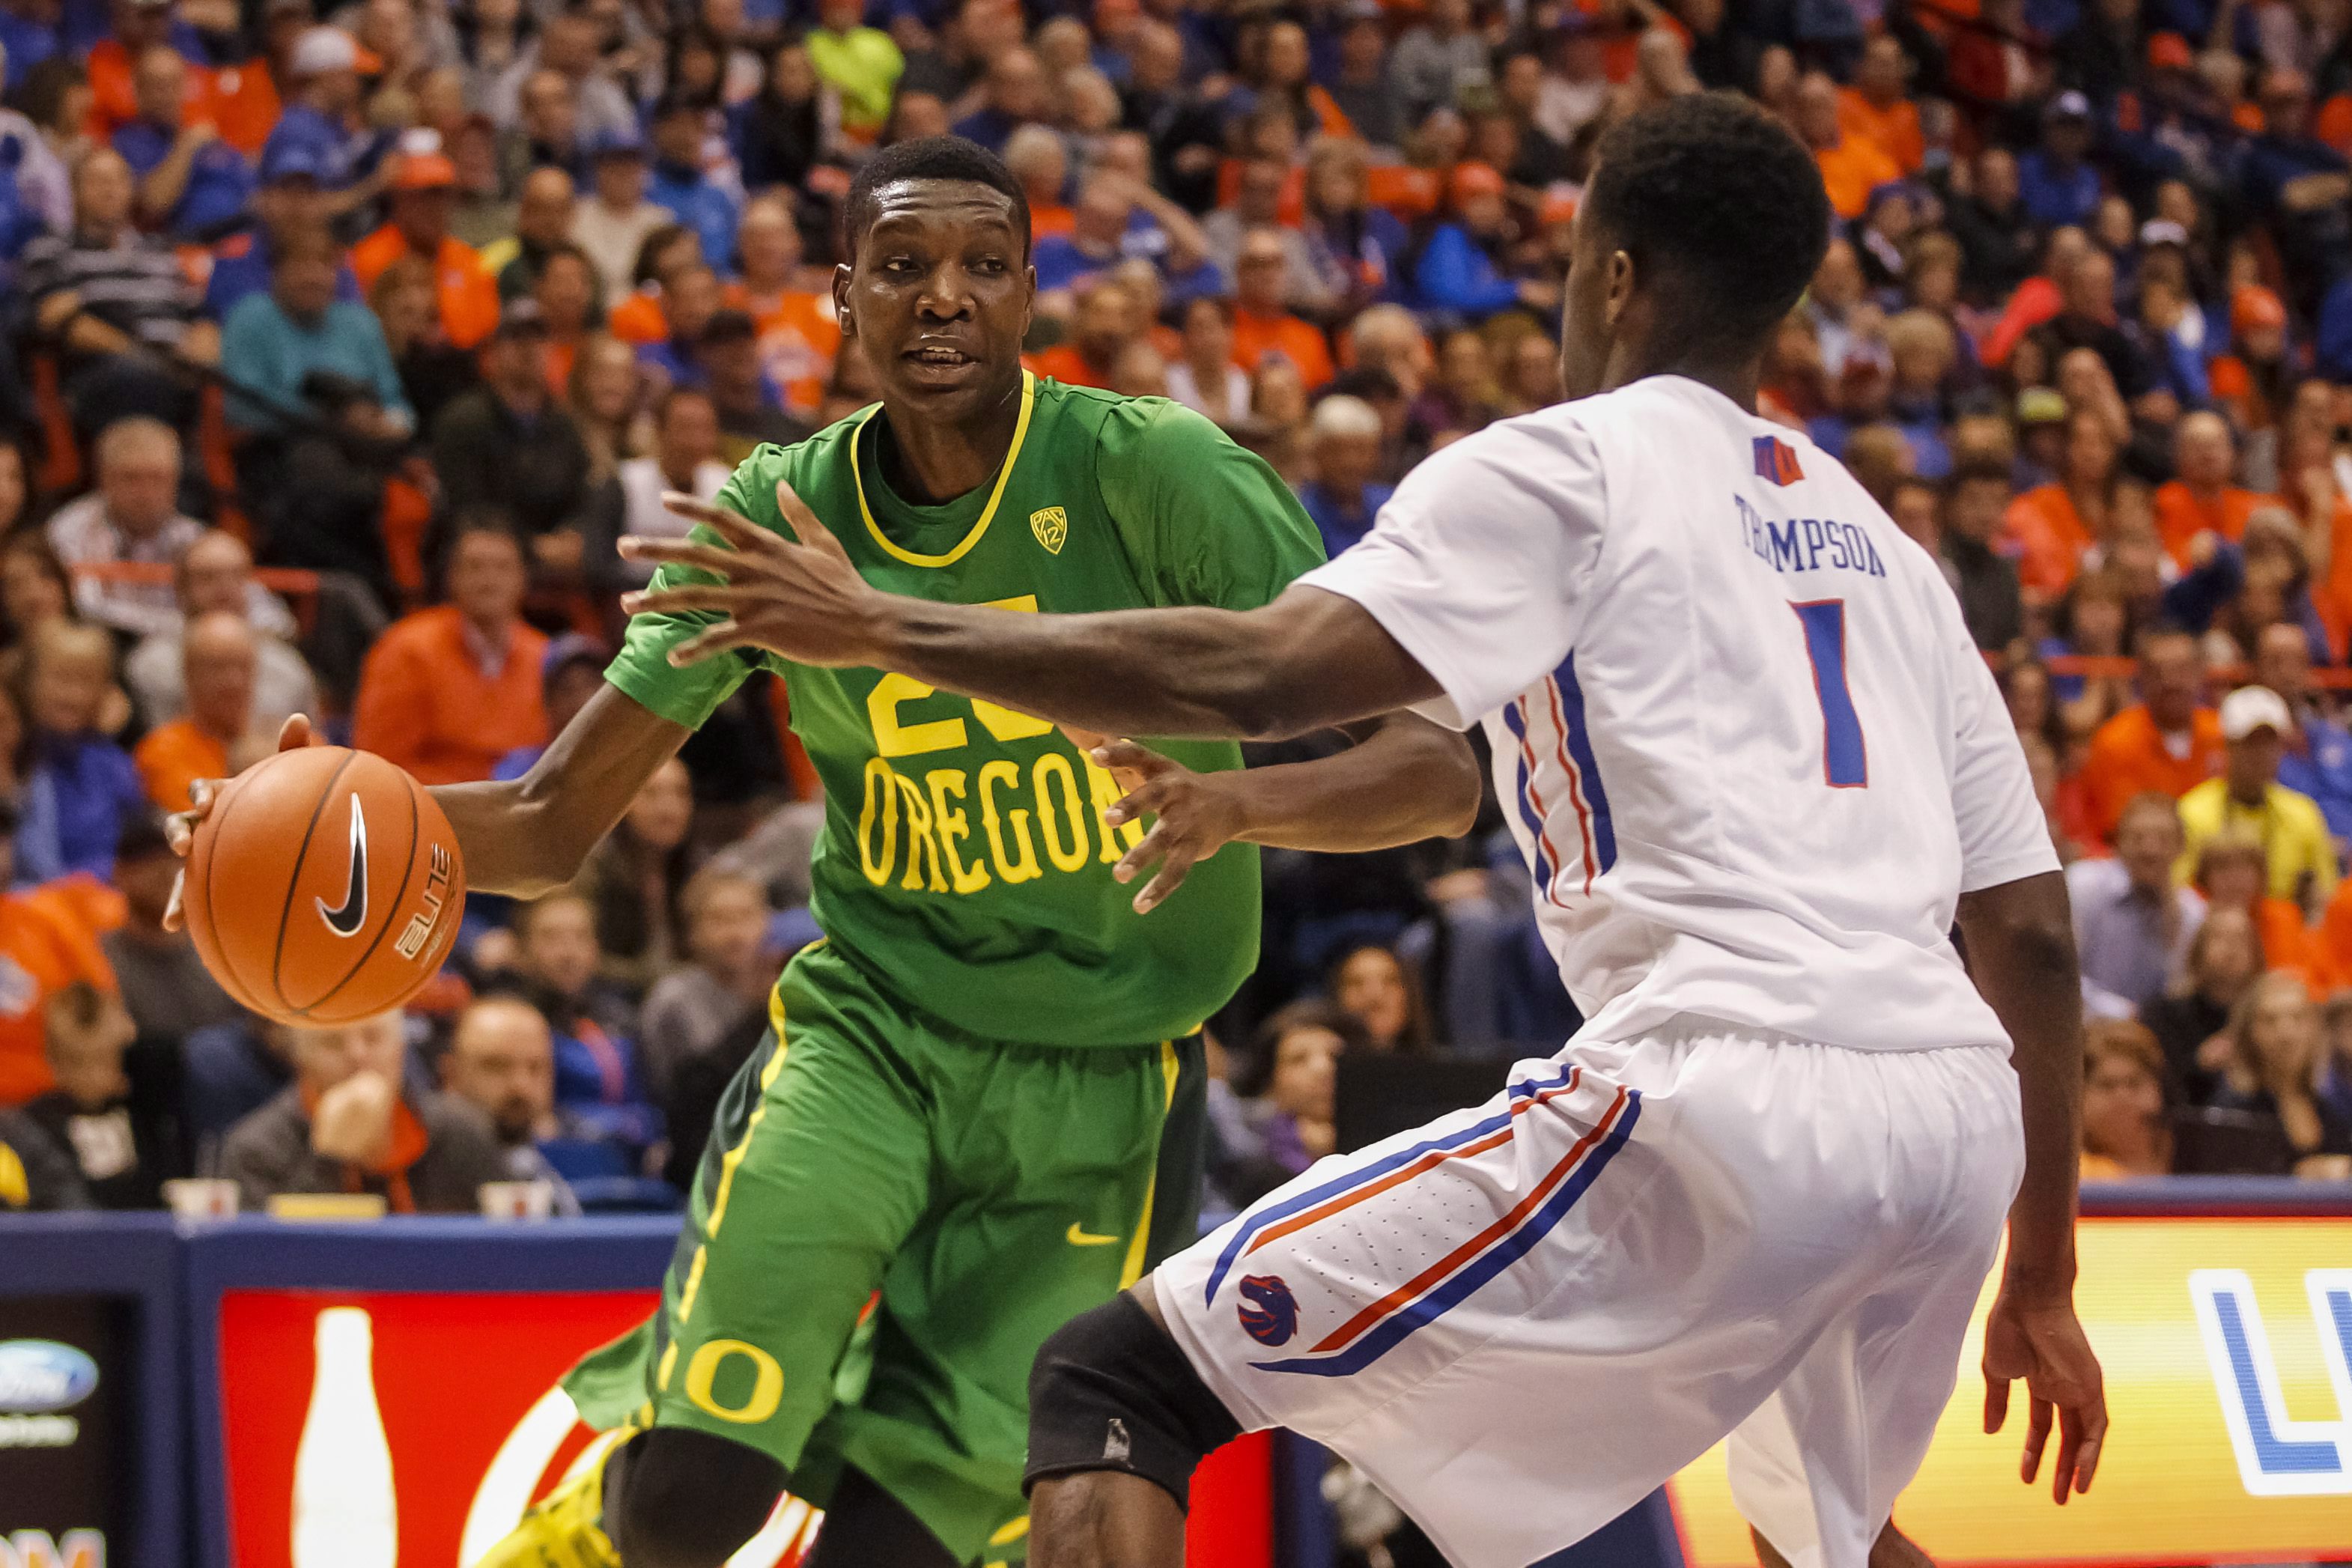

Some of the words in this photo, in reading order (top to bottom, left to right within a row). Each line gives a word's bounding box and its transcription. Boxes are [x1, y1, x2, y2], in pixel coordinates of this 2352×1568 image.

[1033, 510, 1064, 538] PAC
[1043, 526, 1061, 545] 12
[867, 595, 1054, 758] 2
[1786, 598, 1868, 788] 1
[858, 739, 1145, 895] OREGON
[394, 848, 451, 961] ELITE
[685, 1339, 785, 1424] O
